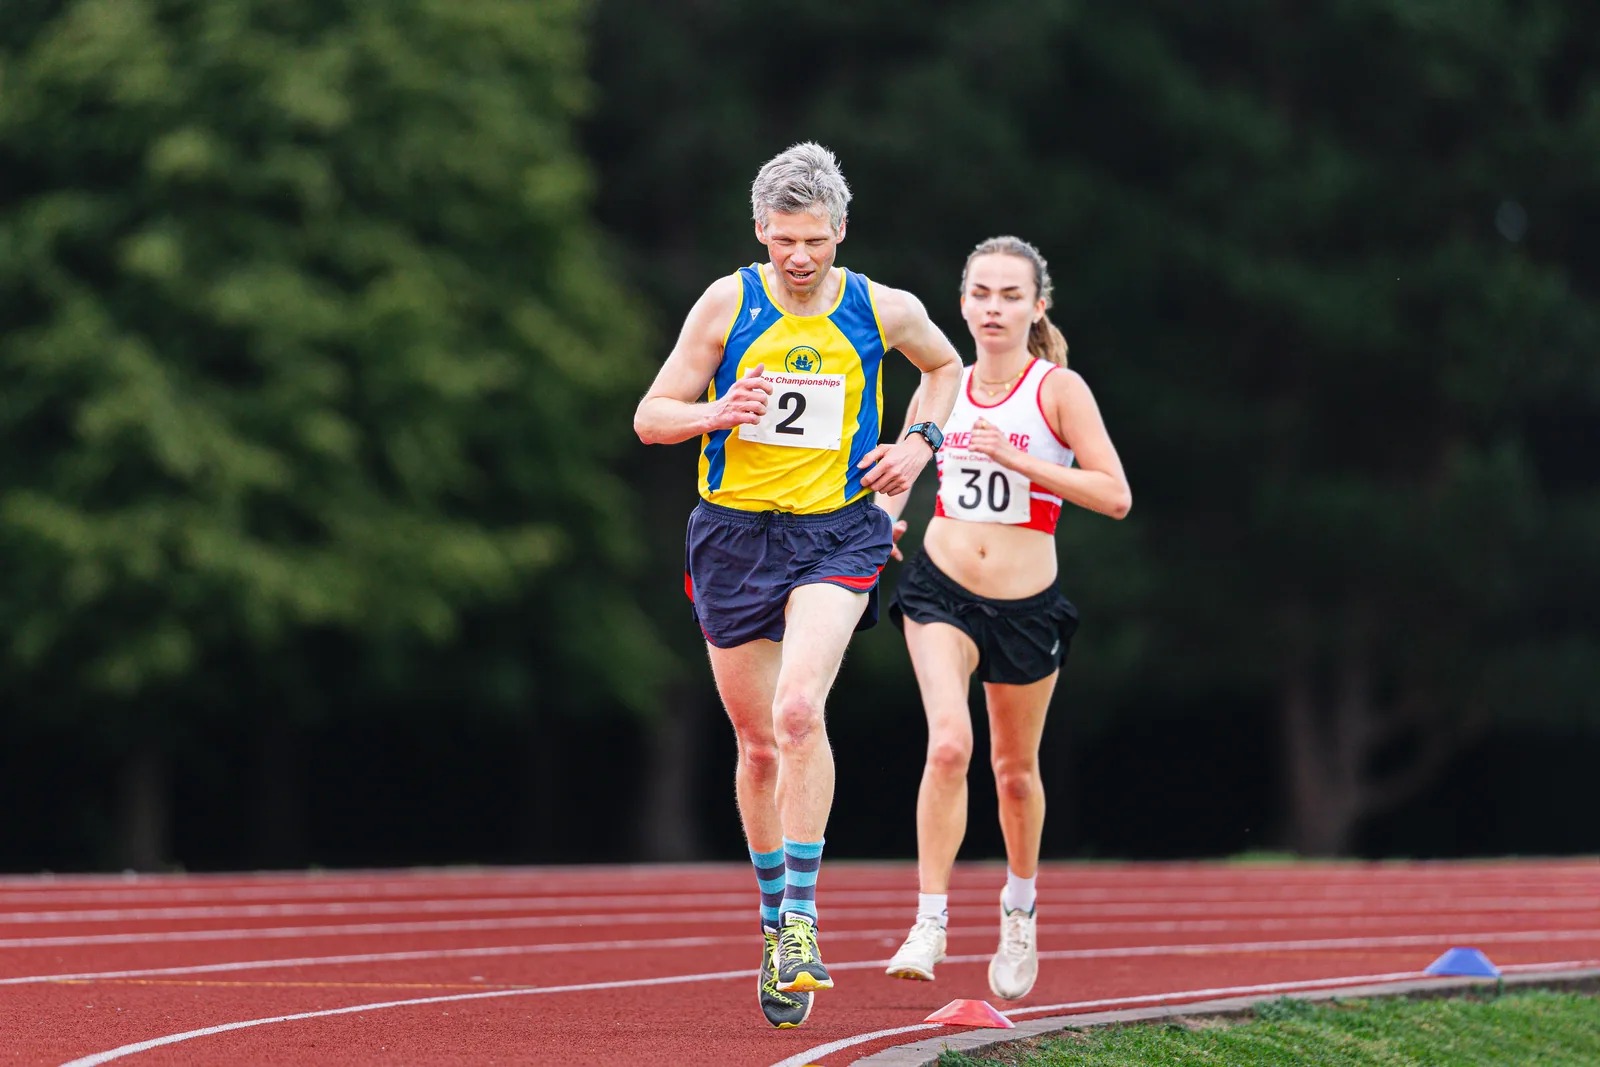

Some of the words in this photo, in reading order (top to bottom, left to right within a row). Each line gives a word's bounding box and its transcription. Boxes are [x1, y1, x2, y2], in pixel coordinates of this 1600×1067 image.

[775, 376, 841, 388] Championships
[775, 391, 807, 436] 2
[1009, 432, 1030, 448] RC
[958, 468, 1010, 512] 30
[762, 984, 803, 1009] BROOKS
